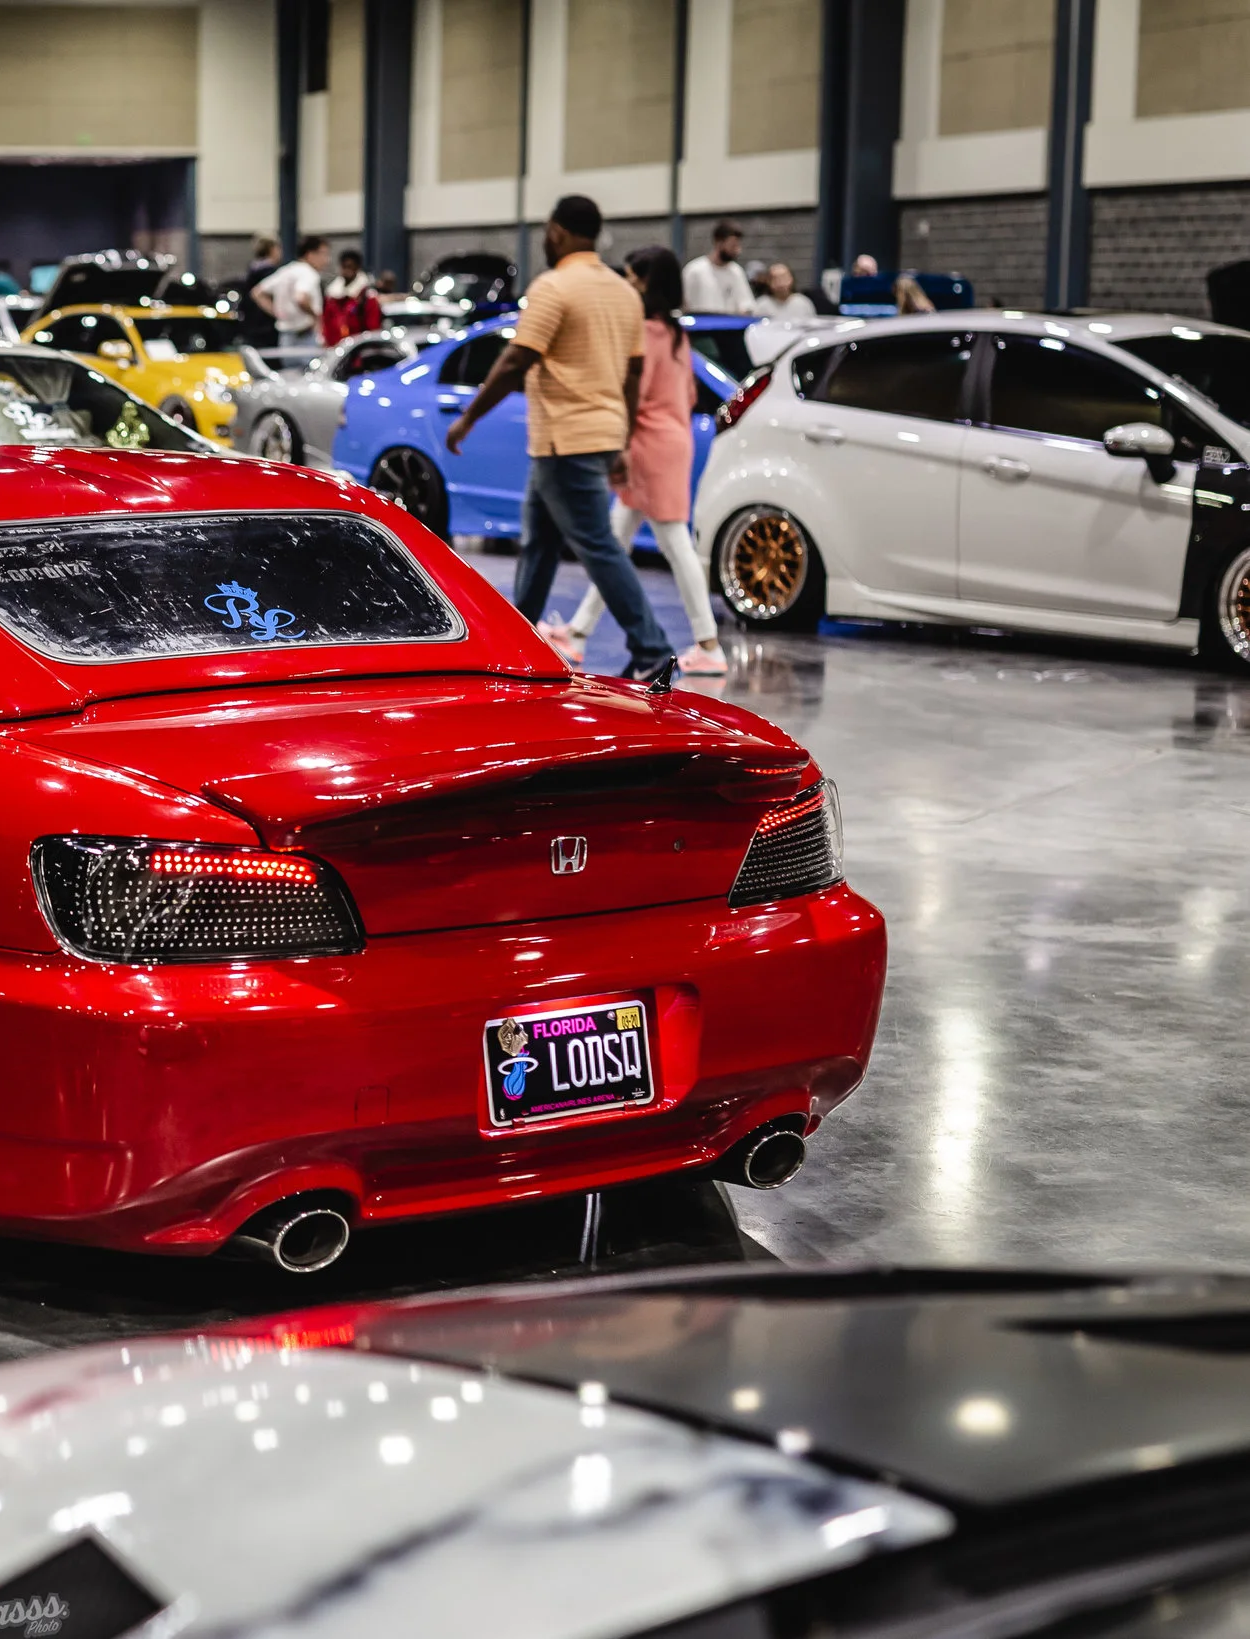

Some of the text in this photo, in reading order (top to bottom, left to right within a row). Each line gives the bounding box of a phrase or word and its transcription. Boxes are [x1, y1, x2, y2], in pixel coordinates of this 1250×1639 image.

[533, 1016, 597, 1039] FLORIDA
[548, 1030, 642, 1092] LODSQ
[593, 1094, 615, 1103] ARENA
